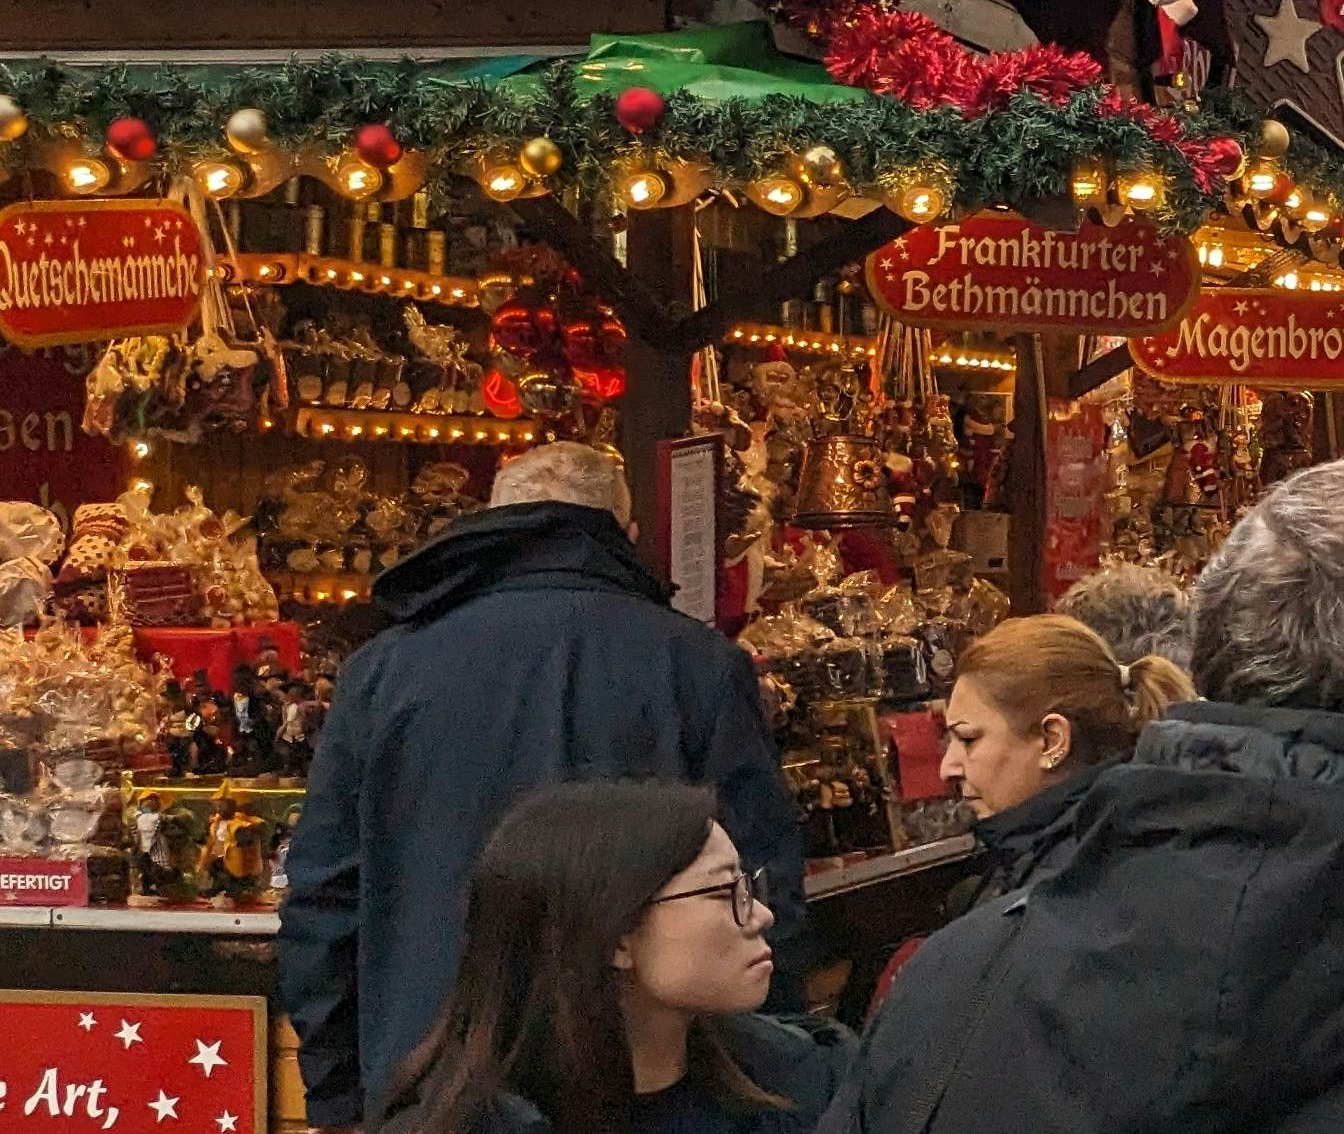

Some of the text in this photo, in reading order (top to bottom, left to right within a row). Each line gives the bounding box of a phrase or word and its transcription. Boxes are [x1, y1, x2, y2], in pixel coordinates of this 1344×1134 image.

[927, 225, 1144, 272] Frankfurter
[902, 270, 1167, 320] Bethmännchen
[0, 874, 72, 891] EFERTIGT
[24, 1067, 119, 1130] Art,
